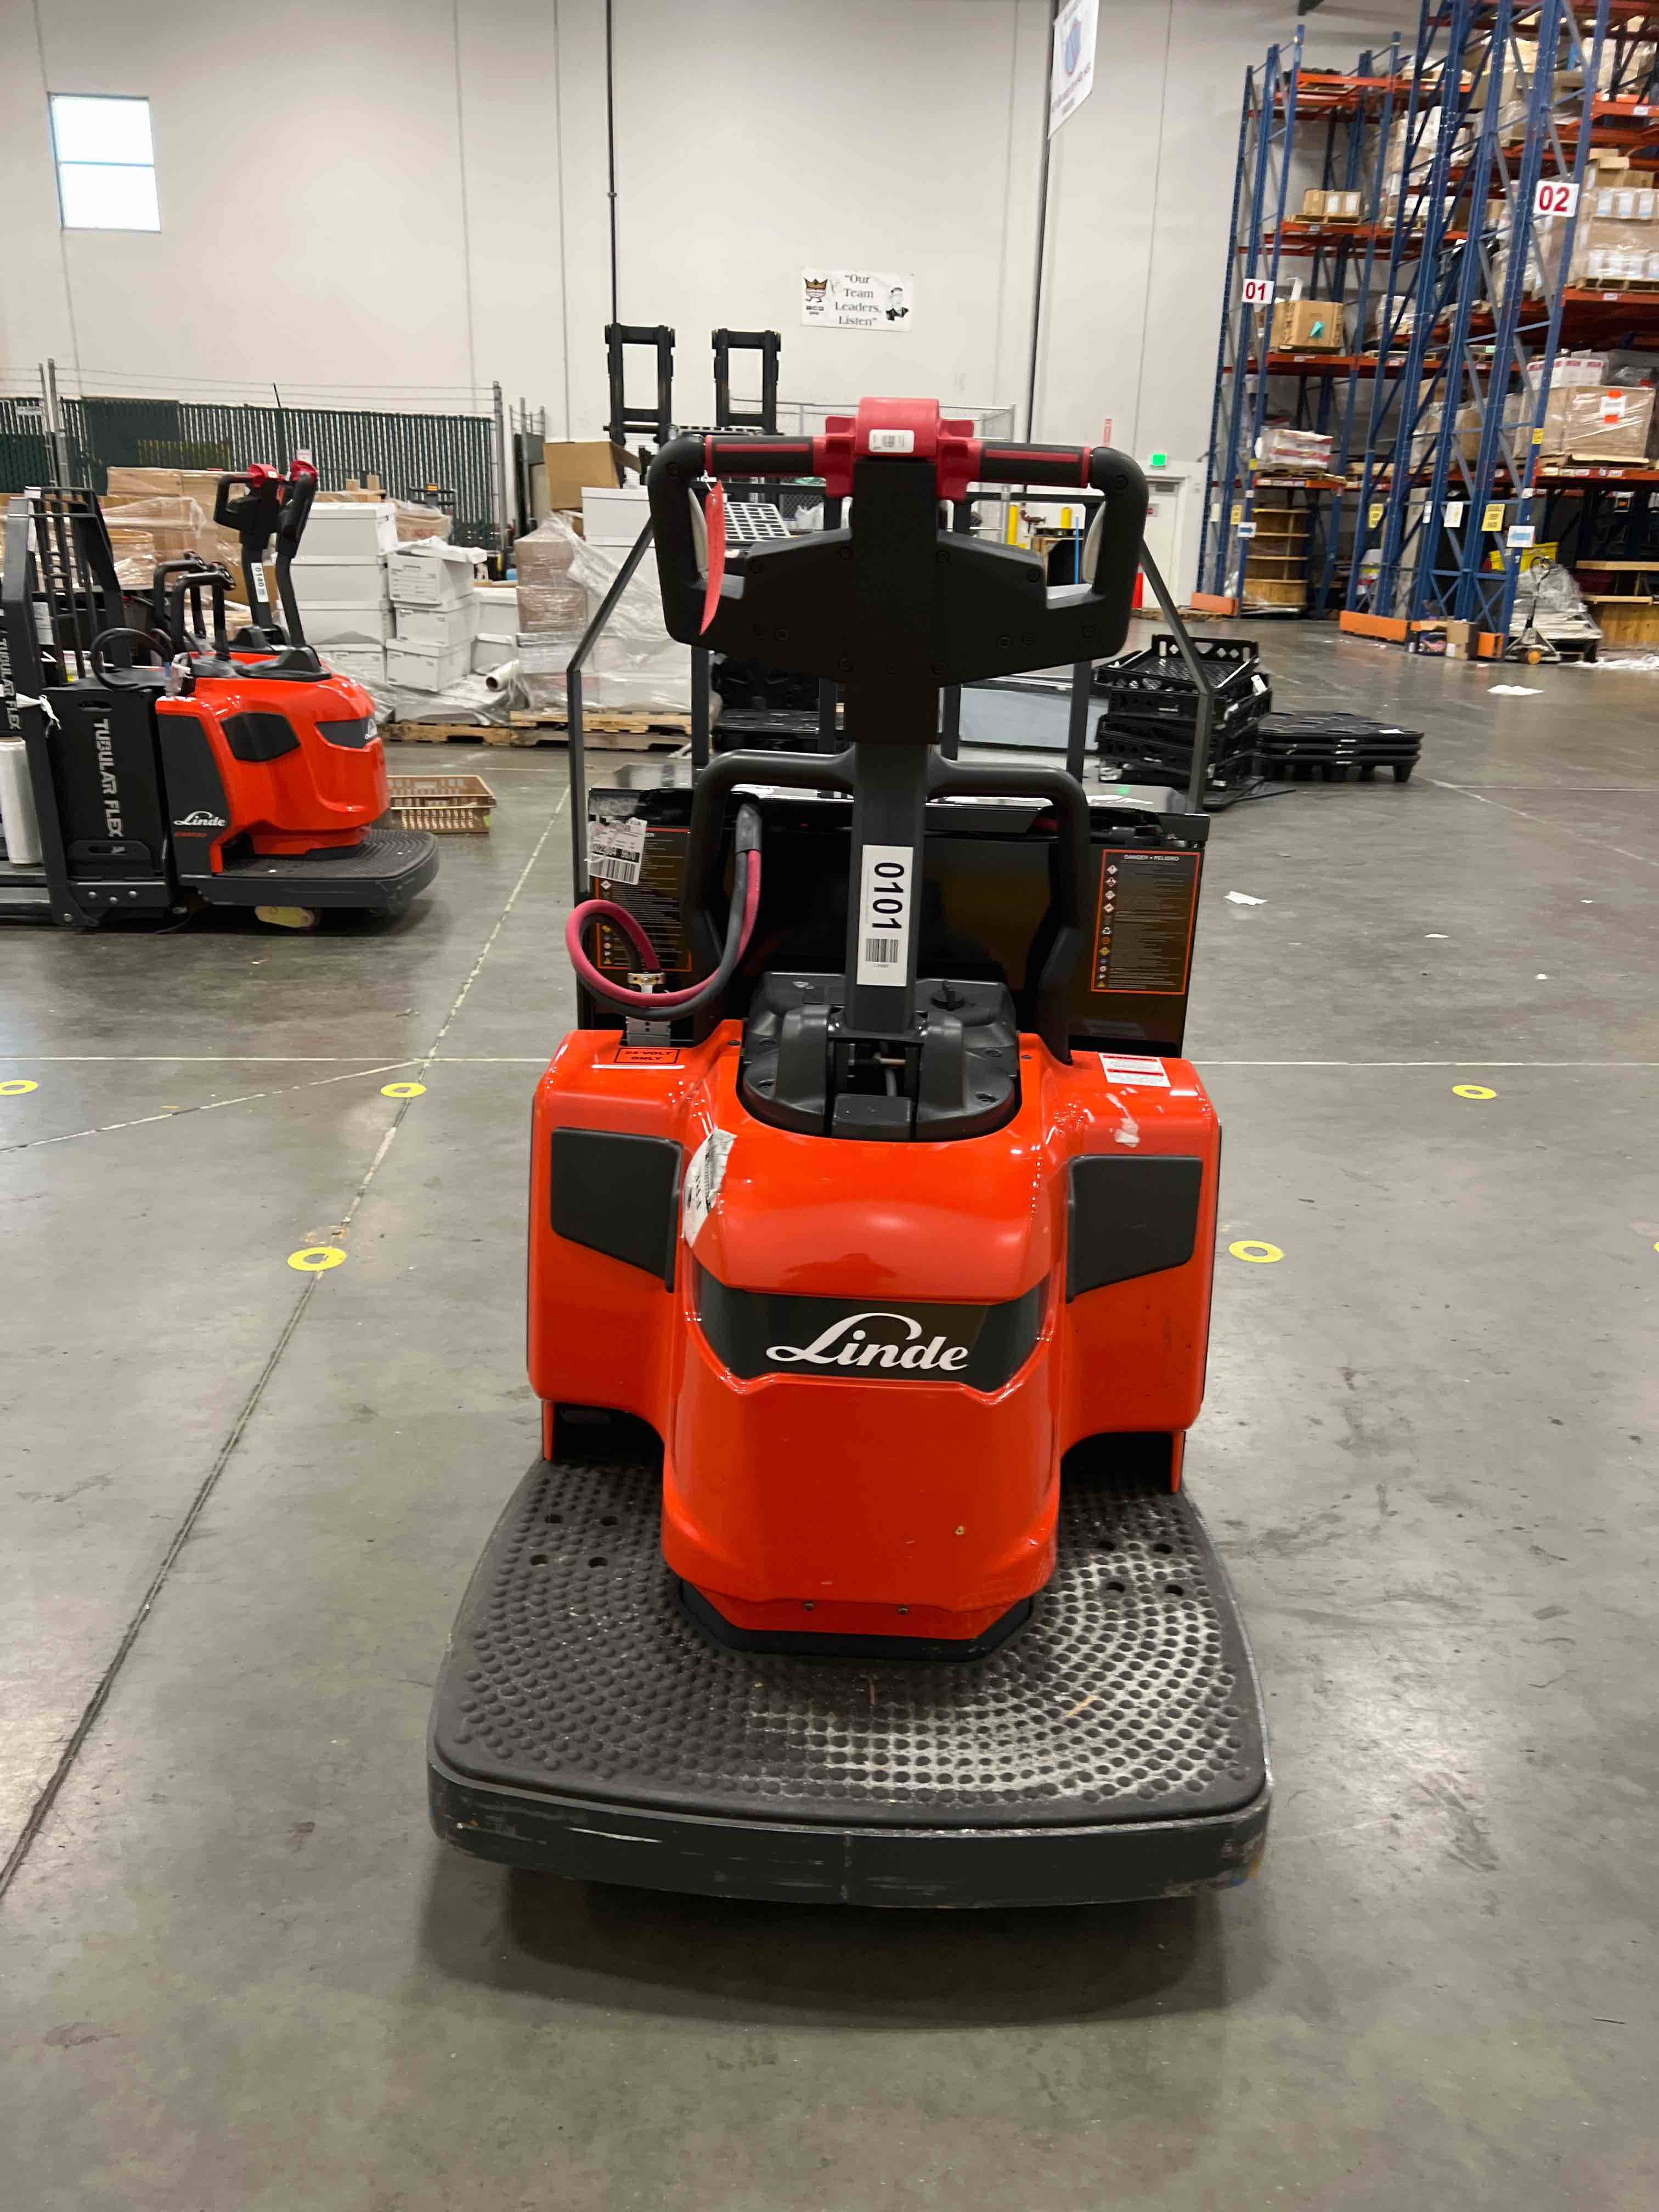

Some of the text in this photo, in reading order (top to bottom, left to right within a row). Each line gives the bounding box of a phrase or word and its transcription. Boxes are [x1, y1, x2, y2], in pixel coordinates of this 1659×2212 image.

[1539, 185, 1570, 212] 02
[843, 288, 873, 298] Team
[1245, 281, 1266, 301] 01
[5, 700, 21, 729] FLEX
[93, 718, 117, 794] TUBULAR
[104, 799, 125, 838] FLEX
[173, 811, 227, 826] Linde
[871, 862, 905, 929] 0101
[765, 1312, 969, 1371] Linde
